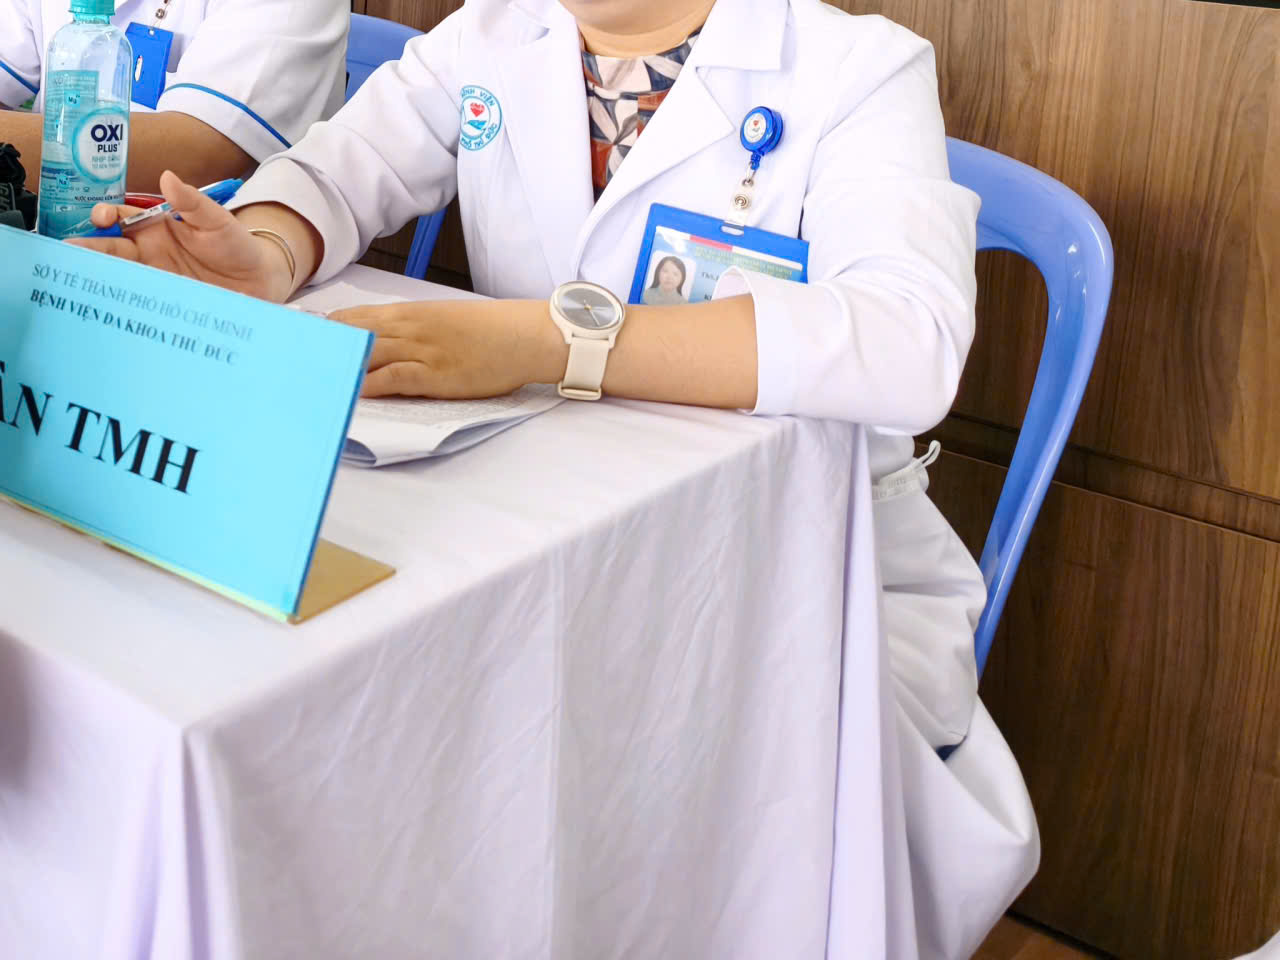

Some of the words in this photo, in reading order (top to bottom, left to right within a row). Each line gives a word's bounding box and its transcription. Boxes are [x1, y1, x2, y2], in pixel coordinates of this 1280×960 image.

[90, 123, 124, 142] OXI
[97, 143, 118, 153] PLUS
[30, 287, 67, 311] BỆNH
[69, 298, 101, 323] VIỆN
[123, 318, 167, 344] KHOA
[32, 263, 51, 280] SỞ
[52, 267, 62, 282] Y
[81, 277, 127, 303] THÀNH
[183, 306, 210, 327] CHÍ
[211, 317, 254, 342] MINH
[64, 402, 202, 496] TMH
